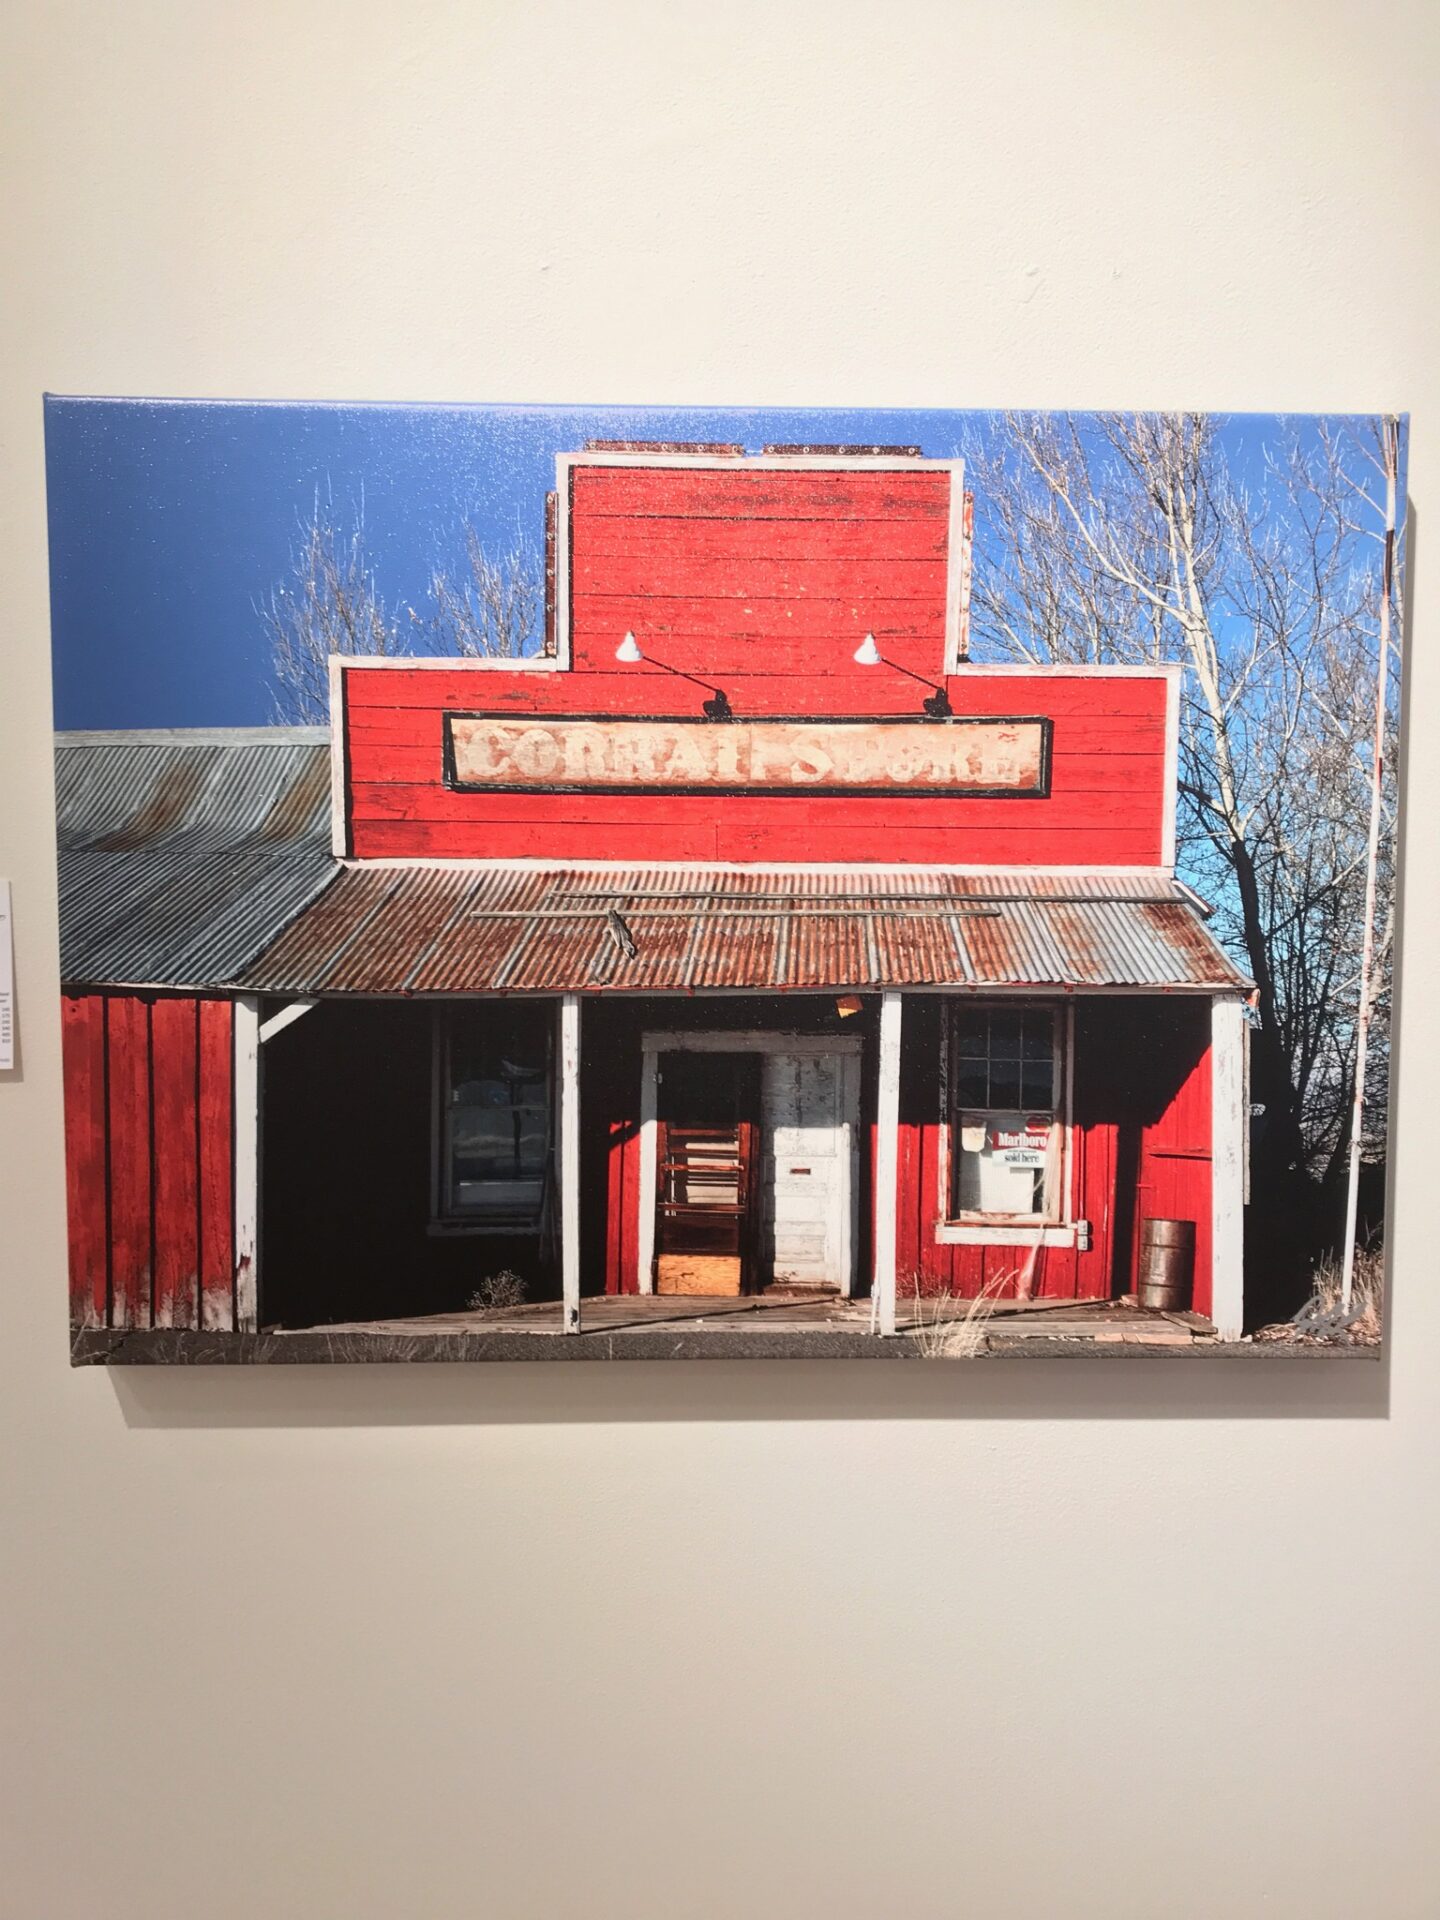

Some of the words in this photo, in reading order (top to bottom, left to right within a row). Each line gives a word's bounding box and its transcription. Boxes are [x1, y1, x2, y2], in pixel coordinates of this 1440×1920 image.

[998, 1132, 1048, 1147] Marlboro
[1004, 1153, 1020, 1163] sold
[1021, 1153, 1040, 1163] here
